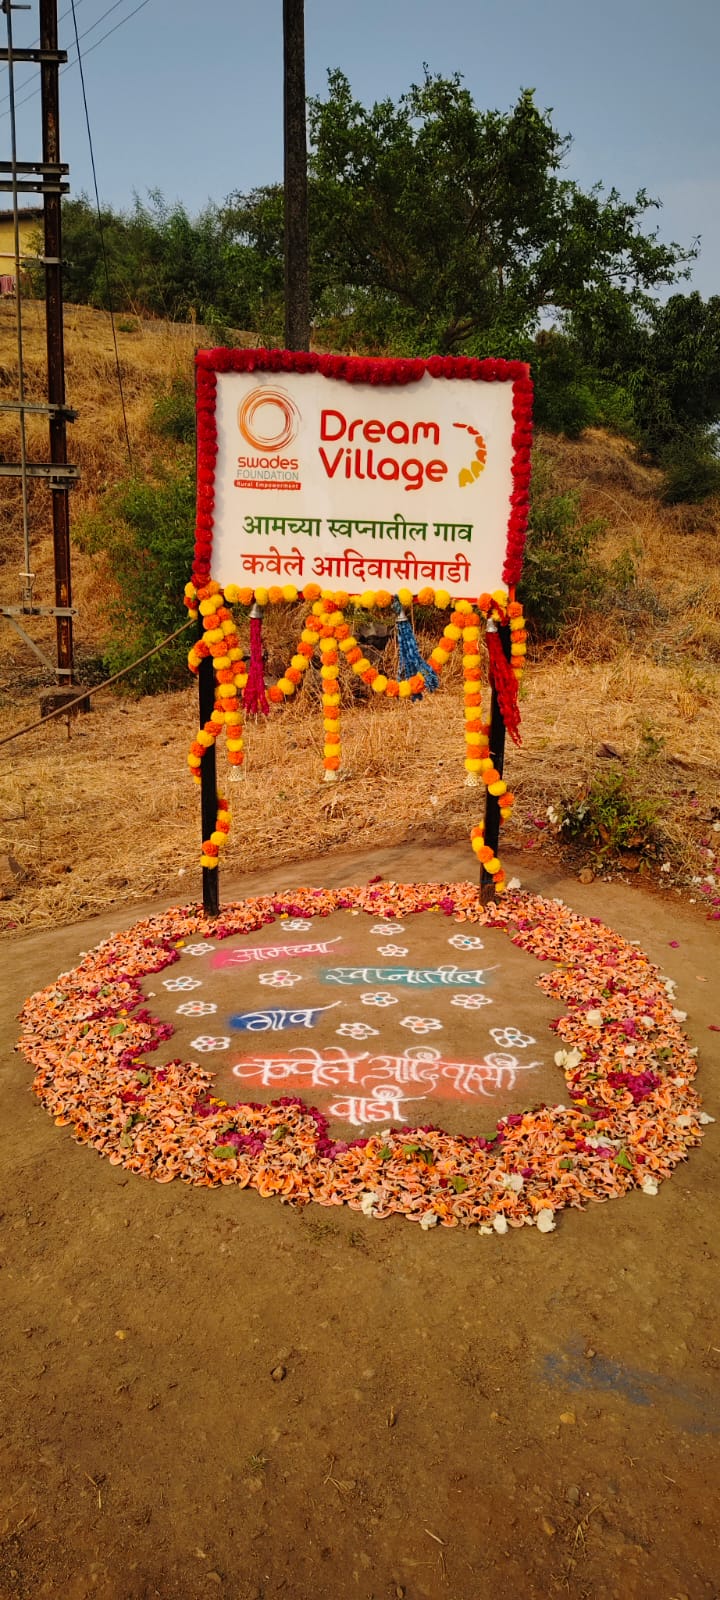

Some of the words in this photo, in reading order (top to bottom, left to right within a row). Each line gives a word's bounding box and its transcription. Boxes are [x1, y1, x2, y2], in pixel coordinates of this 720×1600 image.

[320, 409, 440, 445] Dream
[236, 469, 299, 481] FOUNDATION
[237, 456, 299, 470] swades
[318, 447, 448, 492] Village
[255, 481, 299, 489] Empowerment
[242, 515, 322, 538] आमच्या
[327, 513, 428, 541] स्वप्नातील
[433, 522, 474, 543] गाव
[240, 546, 304, 576] कवेले
[311, 548, 471, 583] आदिवासीवाडी
[229, 936, 342, 962] आमच्या
[325, 964, 501, 986] स्वप्नातील
[241, 1000, 342, 1032] गाव
[232, 1047, 370, 1086] कवेले
[327, 1084, 426, 1126] वाडी
